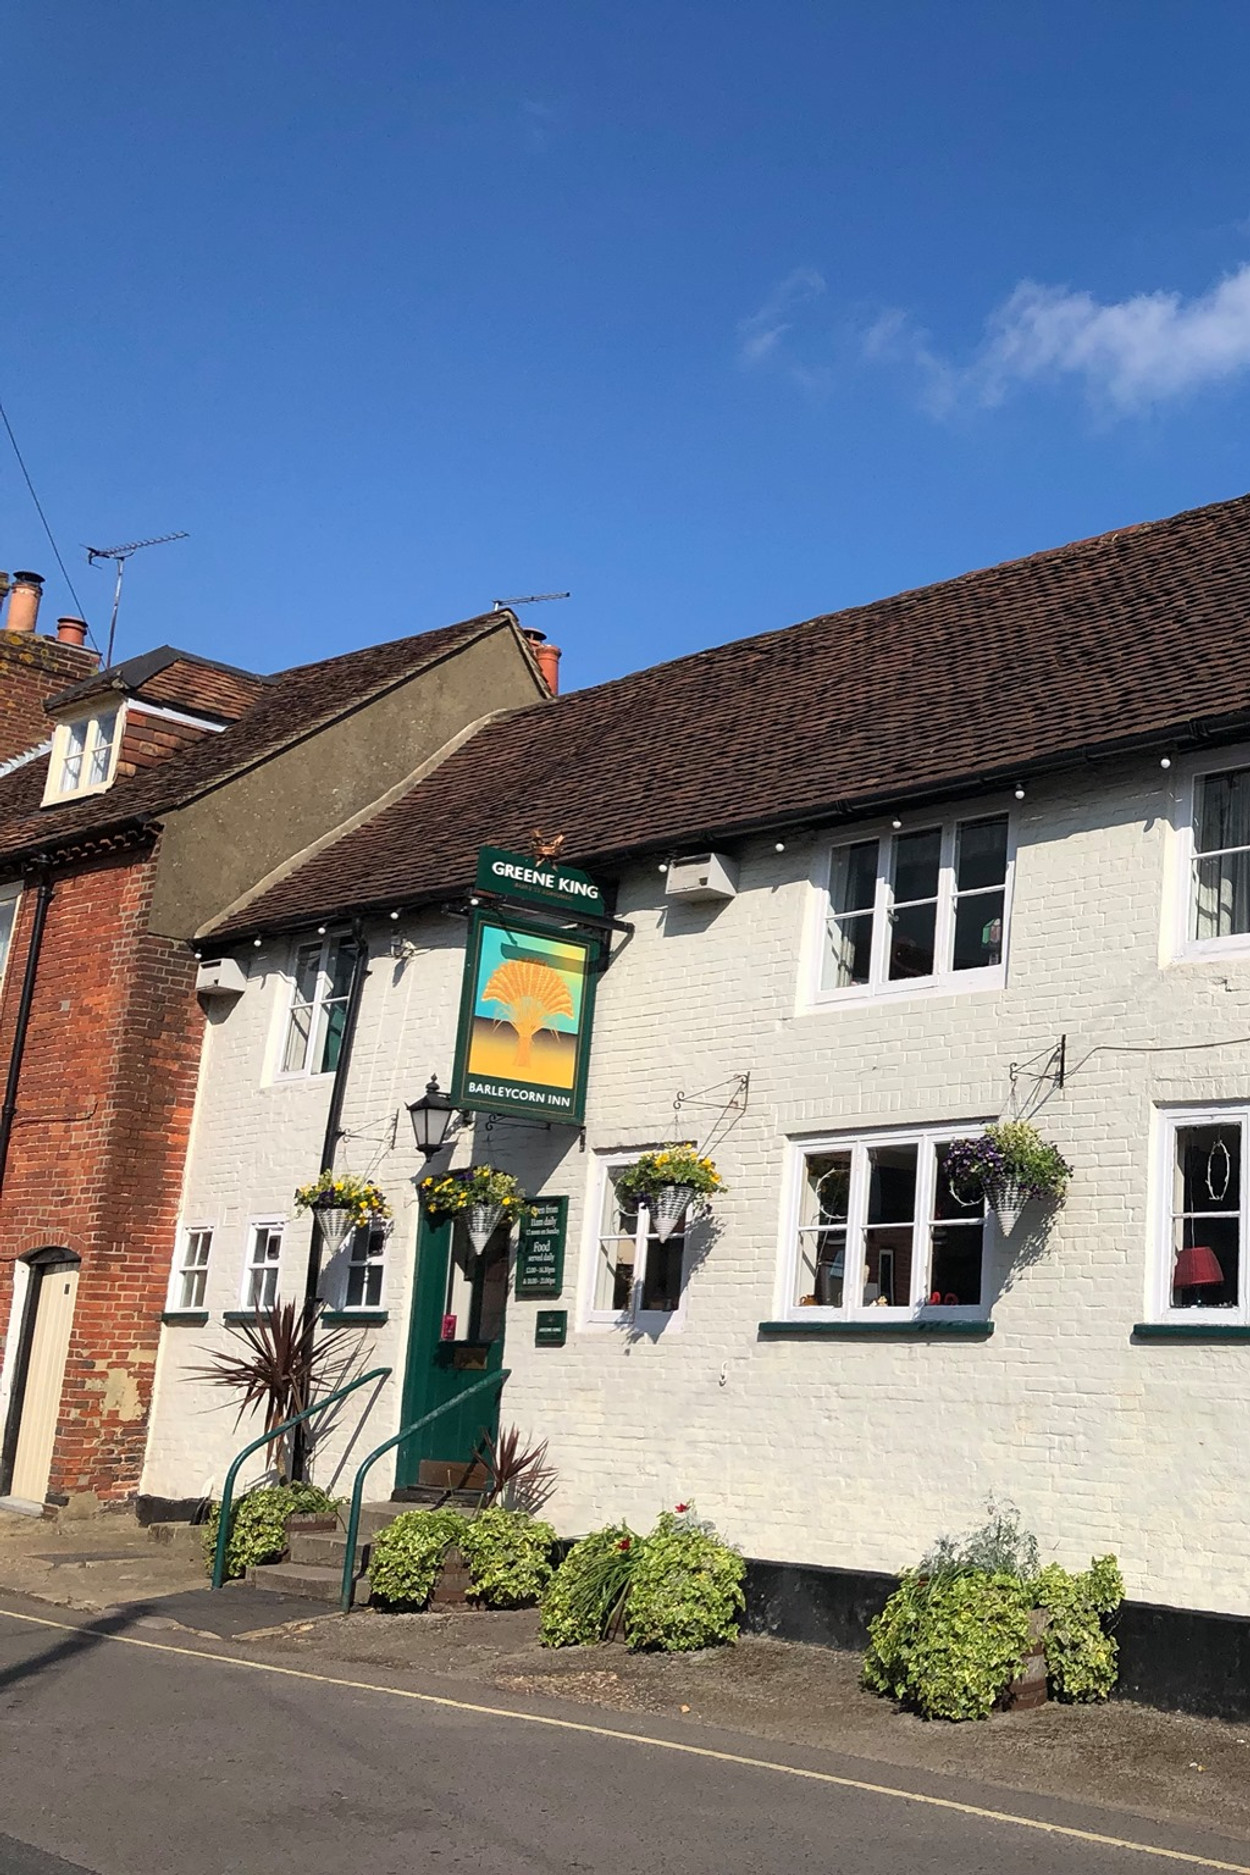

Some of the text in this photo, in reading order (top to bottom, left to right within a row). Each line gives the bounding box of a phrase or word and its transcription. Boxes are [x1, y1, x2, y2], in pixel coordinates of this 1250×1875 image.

[491, 861, 599, 899] GREENE KING
[468, 1082, 571, 1107] BARLEYCORN INN
[534, 1240, 551, 1253] Food
